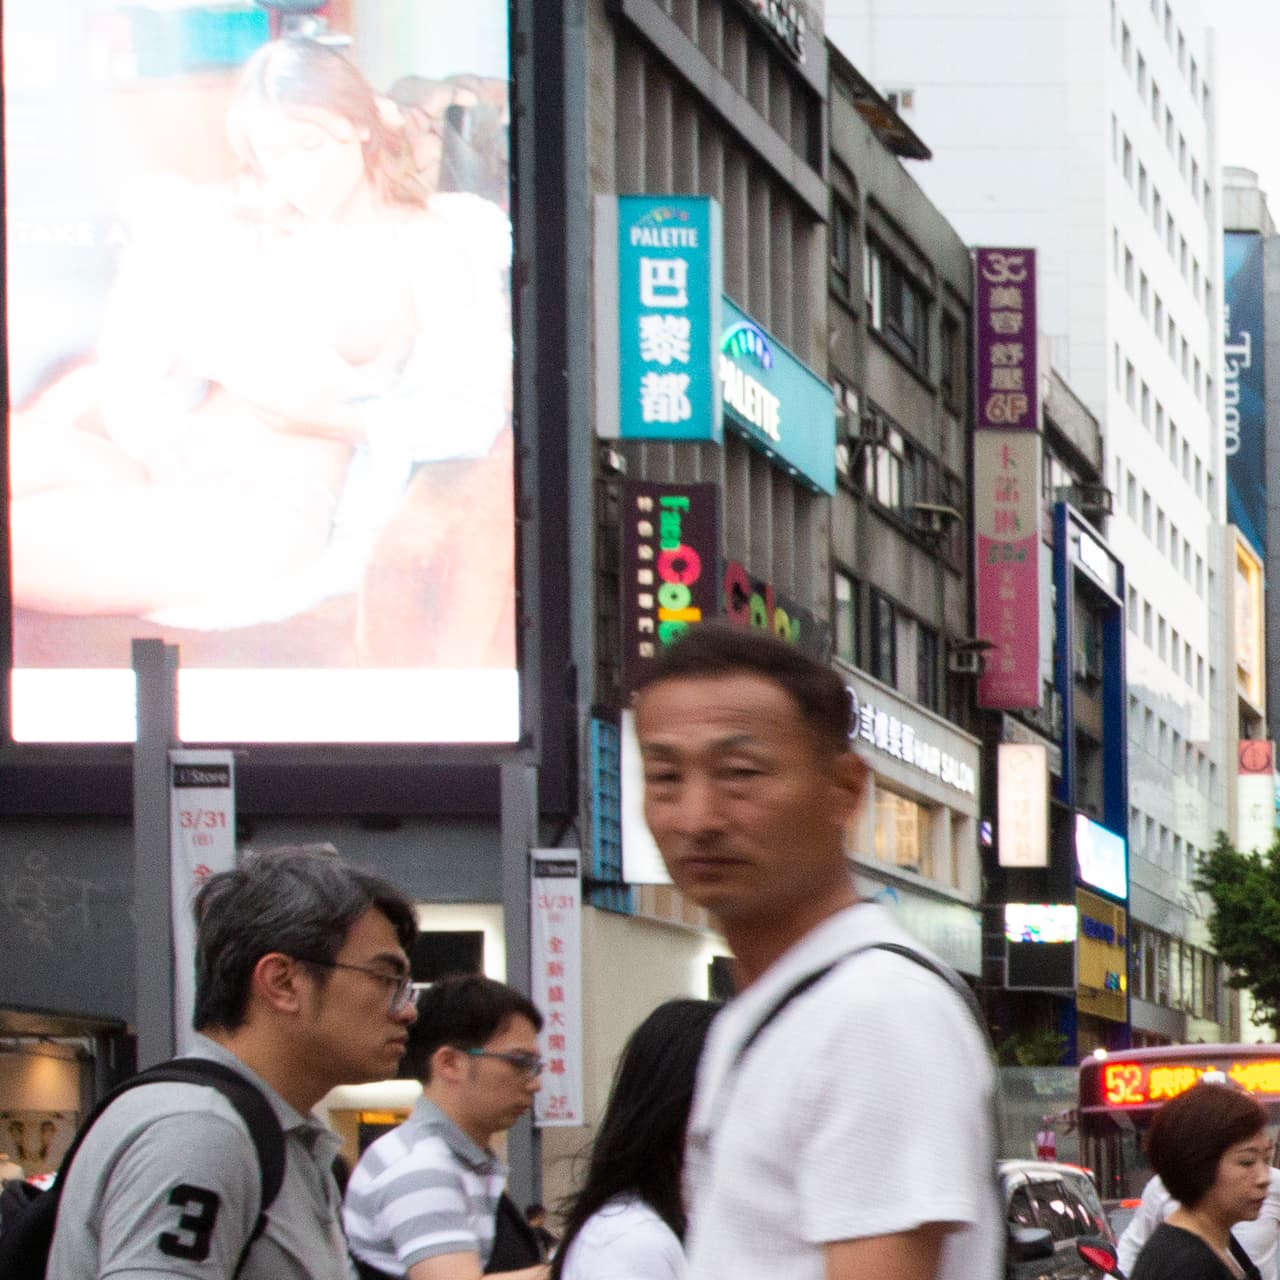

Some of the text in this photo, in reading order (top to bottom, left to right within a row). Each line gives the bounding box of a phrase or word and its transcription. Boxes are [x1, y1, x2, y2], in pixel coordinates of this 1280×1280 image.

[630, 227, 698, 247] PALETTE
[639, 256, 692, 423] 巴黎都
[986, 394, 1028, 423] 6F
[180, 809, 227, 830] 3/31
[537, 895, 575, 910] 3/31
[1105, 1063, 1145, 1103] 52
[157, 1183, 222, 1263] 3
